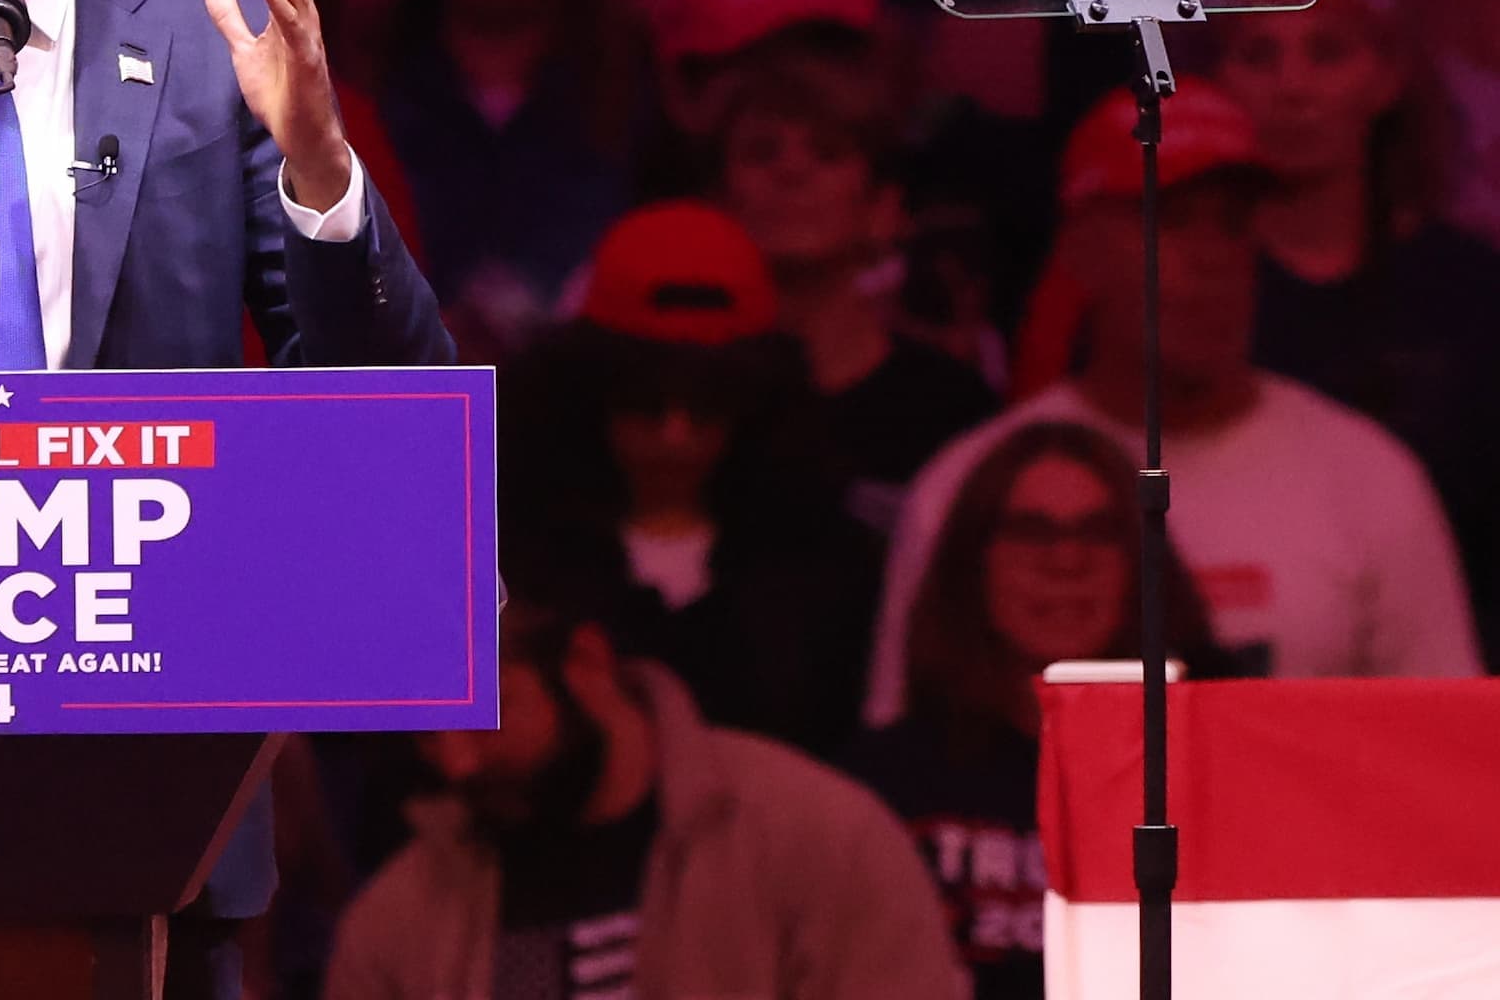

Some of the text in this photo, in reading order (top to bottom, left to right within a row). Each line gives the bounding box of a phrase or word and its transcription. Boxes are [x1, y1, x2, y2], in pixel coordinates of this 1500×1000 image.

[37, 426, 126, 466] FIX
[140, 425, 191, 465] IT
[57, 651, 163, 674] AGAIN!
